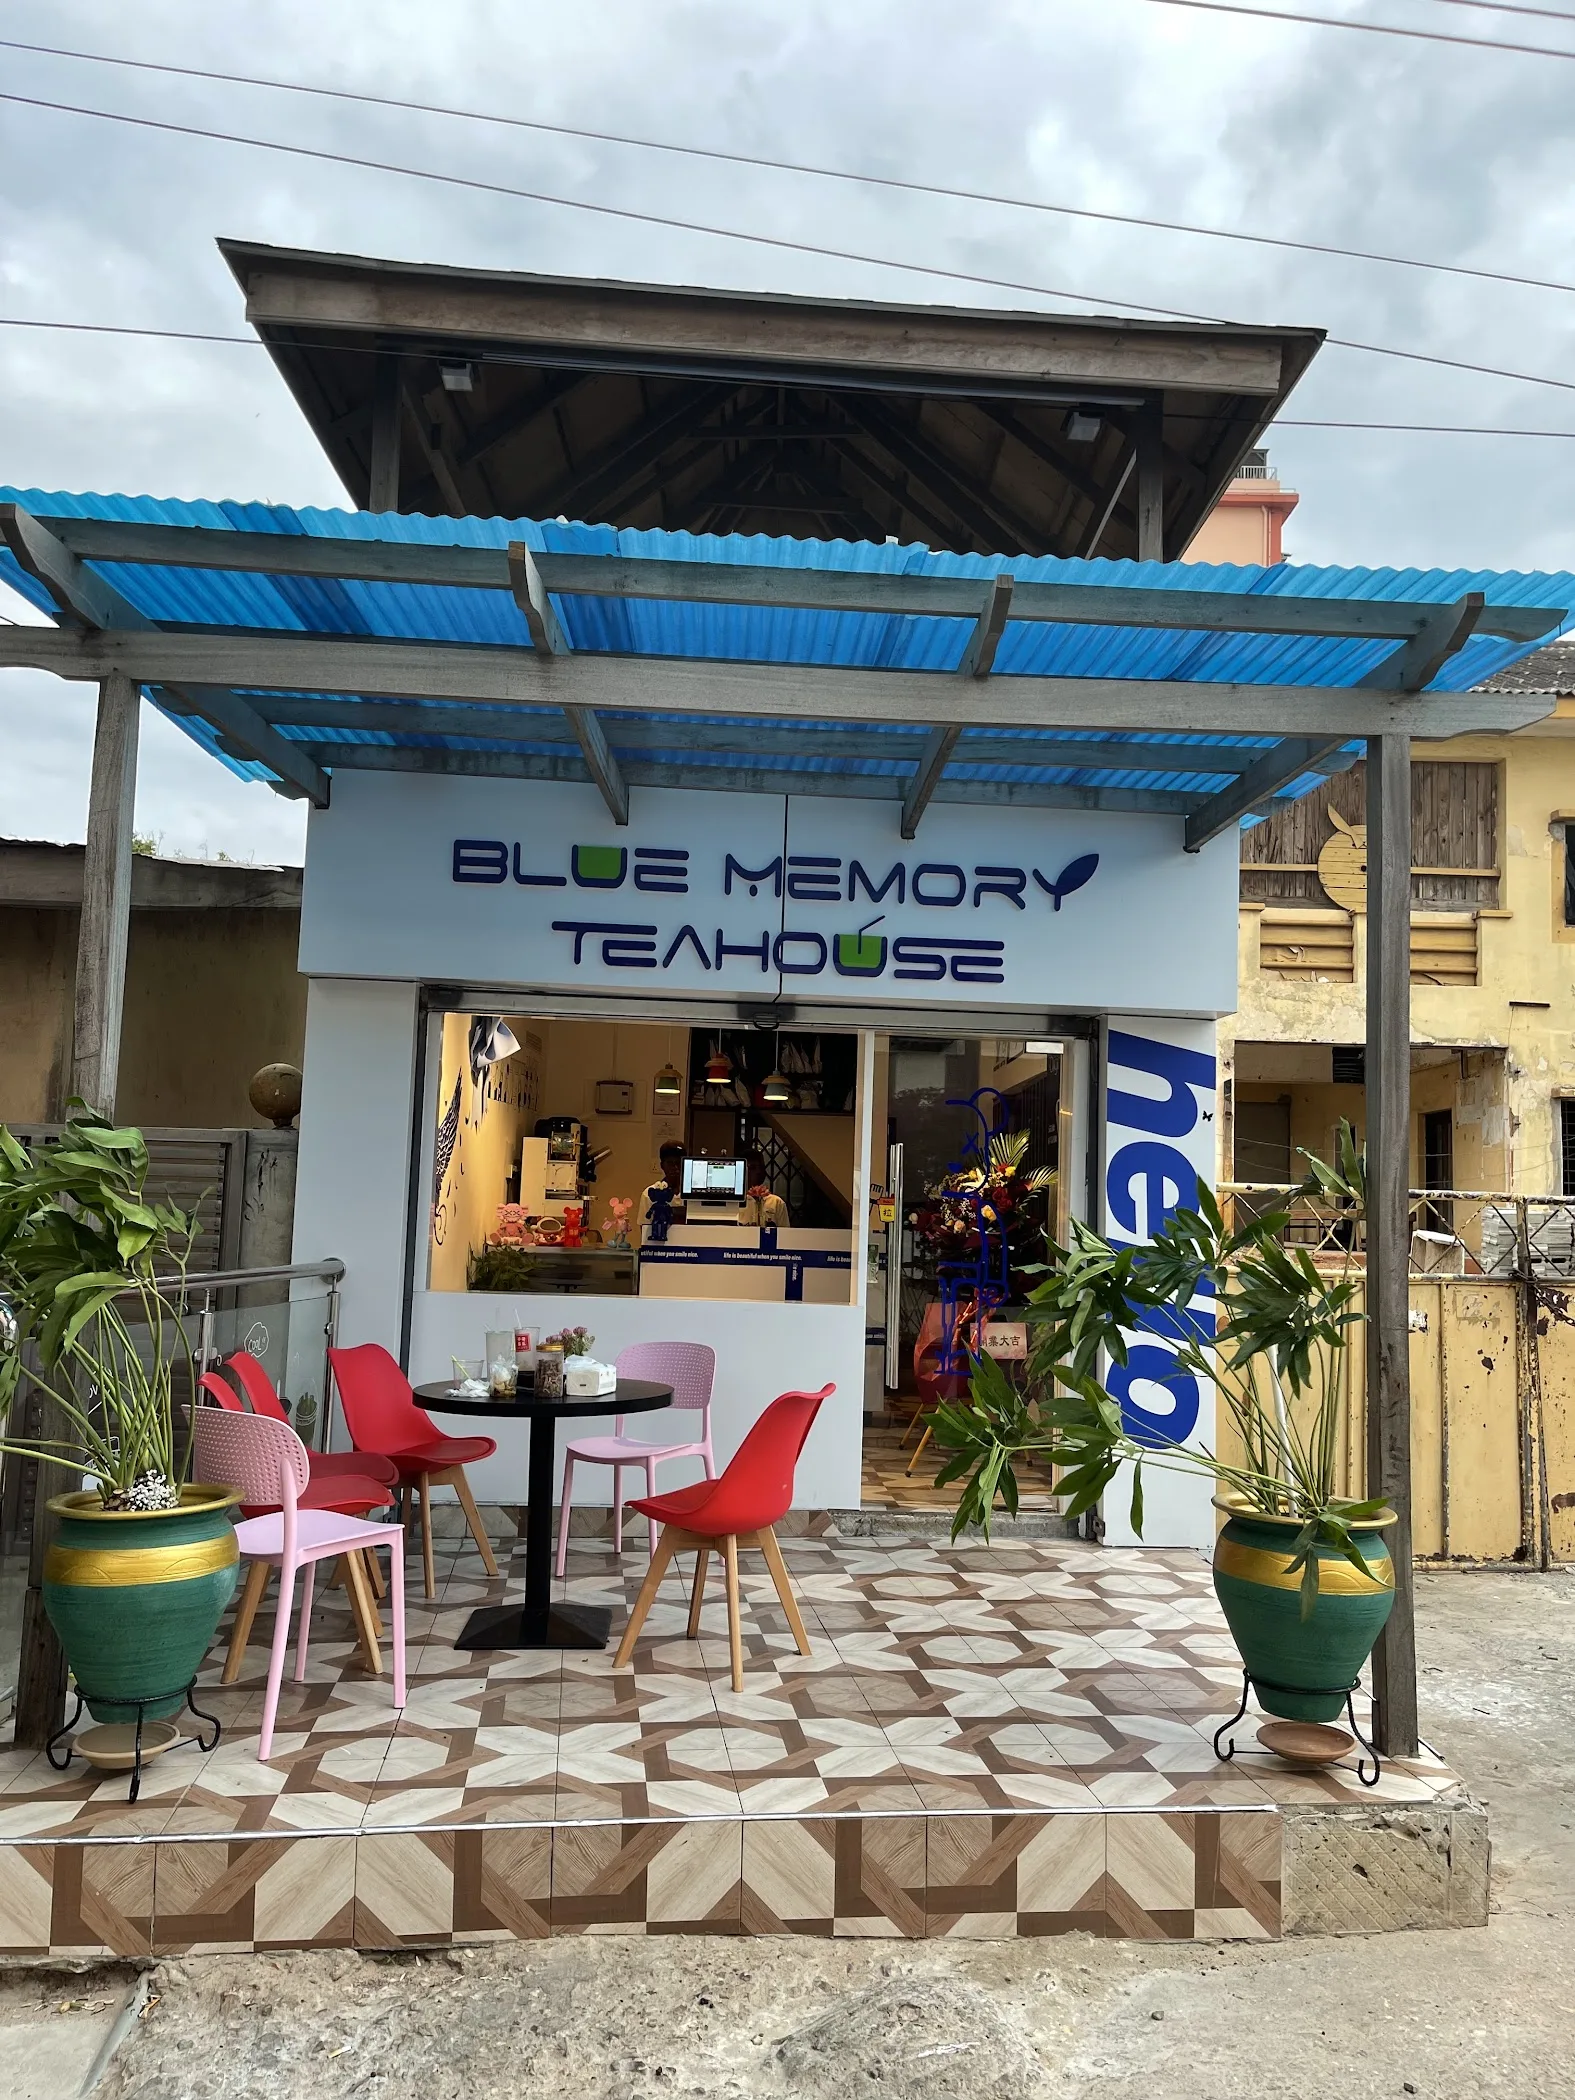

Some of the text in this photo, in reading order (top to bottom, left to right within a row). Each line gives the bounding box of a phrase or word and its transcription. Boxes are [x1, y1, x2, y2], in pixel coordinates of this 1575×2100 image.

[453, 839, 1100, 911] BLUE MEMORY
[552, 915, 1004, 983] TEAHOUSE
